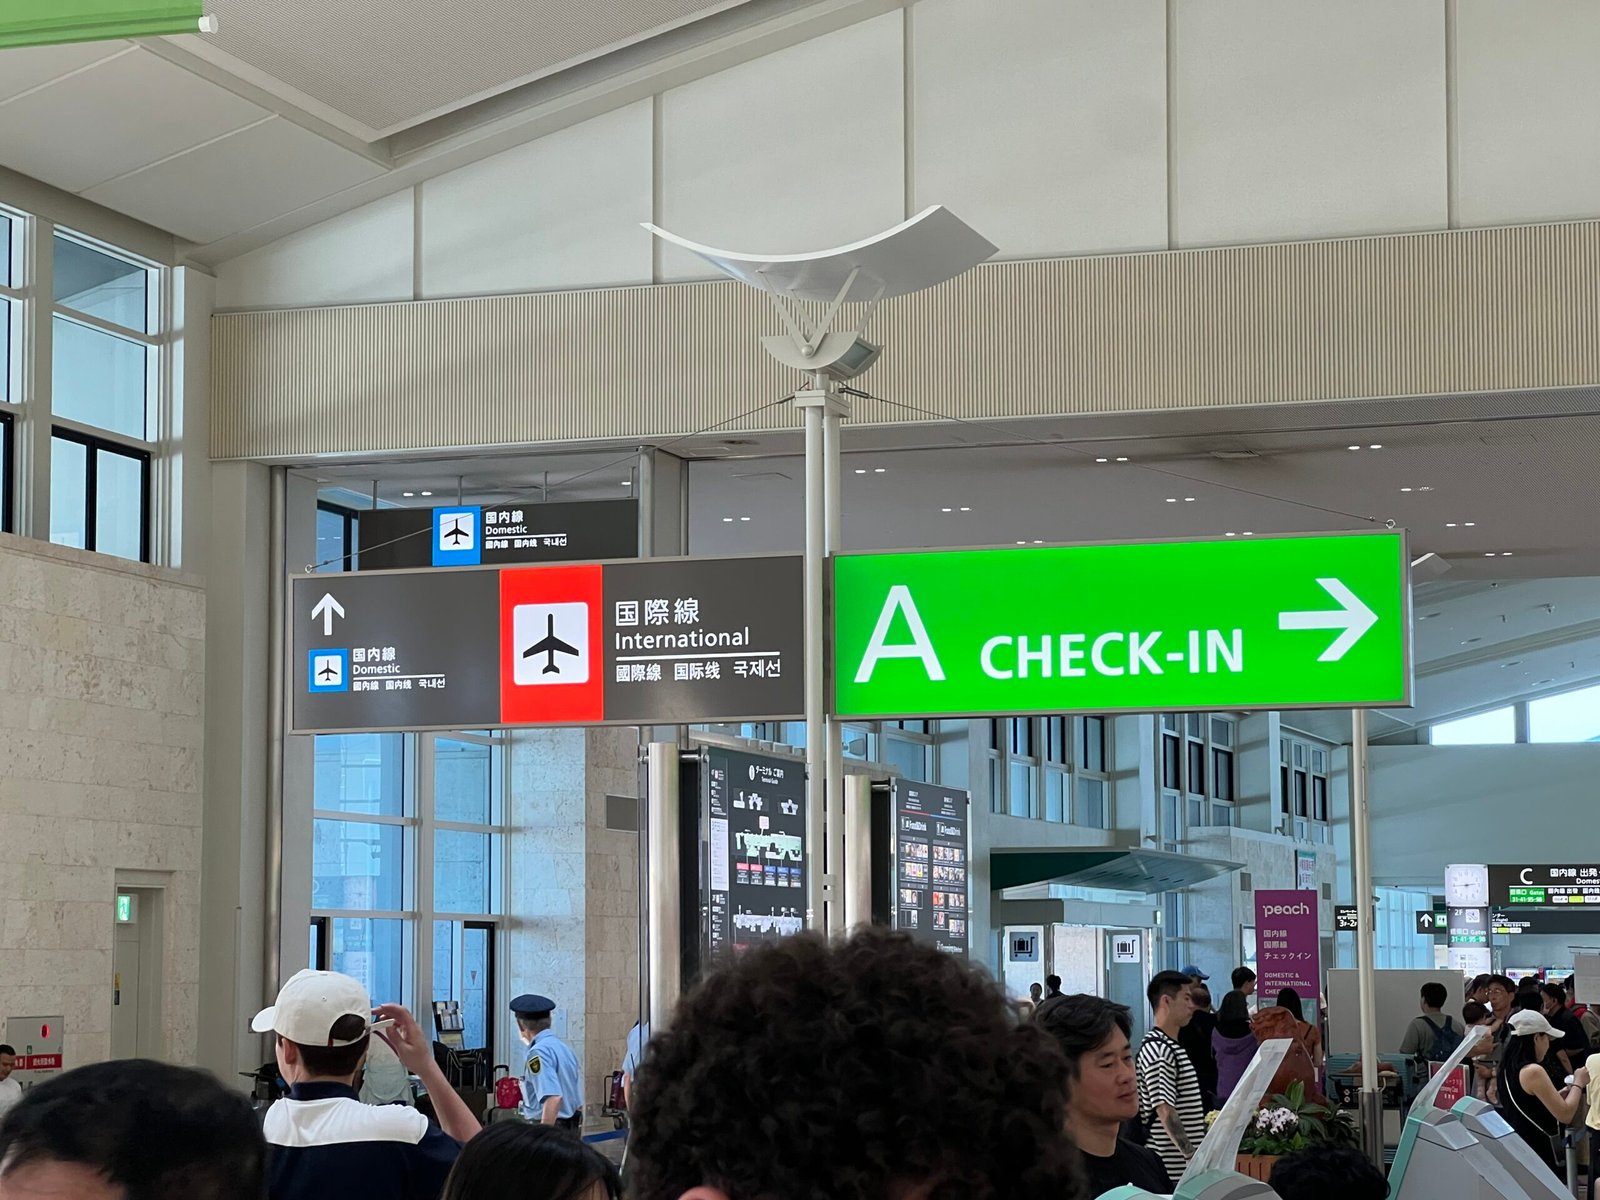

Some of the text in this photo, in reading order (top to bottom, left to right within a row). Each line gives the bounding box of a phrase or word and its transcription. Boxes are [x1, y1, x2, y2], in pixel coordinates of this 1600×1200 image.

[485, 510, 524, 524] 国内線
[485, 525, 528, 535] Domestic
[615, 598, 700, 626] 国際線
[615, 626, 750, 650] International
[854, 585, 1243, 683] A CHECK-IN
[353, 647, 396, 662] 国内線
[353, 663, 400, 675] Domestic
[616, 659, 781, 683] 國際線 国际线 국제선
[418, 678, 446, 689] 국내선
[1520, 868, 1533, 885] C
[1550, 868, 1577, 877] 国内線
[1262, 902, 1309, 918] peach
[1263, 930, 1287, 938] 国内線
[1264, 952, 1312, 960] チェックイン
